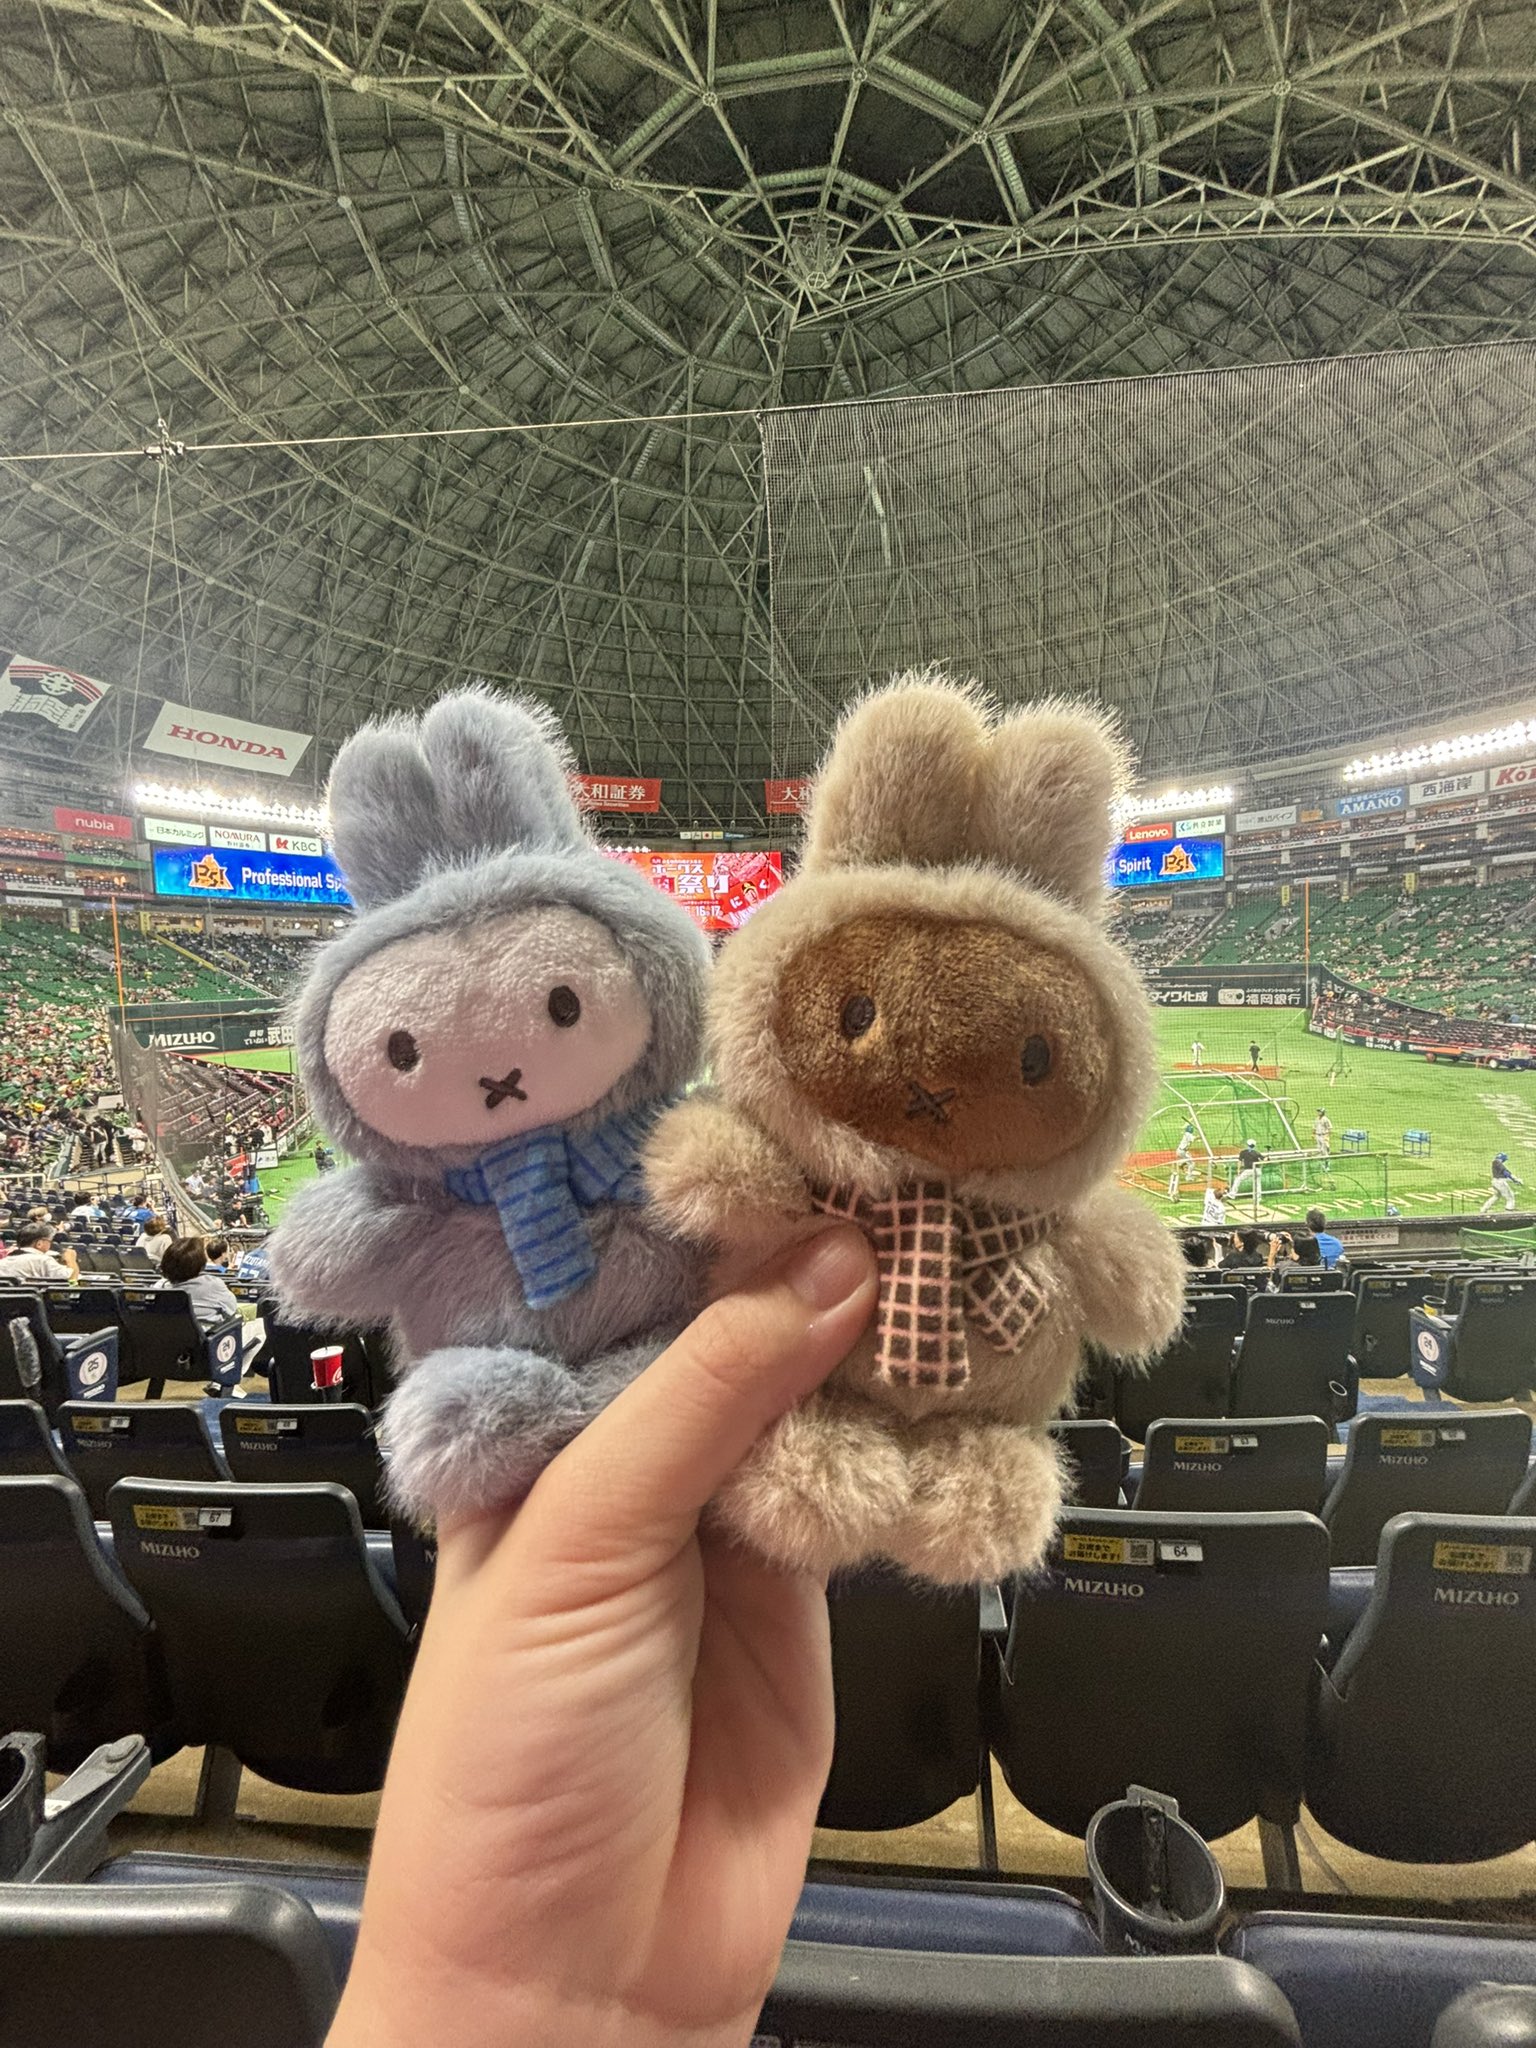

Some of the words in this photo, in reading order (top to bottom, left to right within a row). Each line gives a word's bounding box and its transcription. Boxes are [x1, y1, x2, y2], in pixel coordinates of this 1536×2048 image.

[166, 723, 287, 760] HONDA
[1422, 775, 1473, 797] 西海岸
[1340, 795, 1402, 815] AMANO
[75, 817, 114, 831] nubia
[214, 830, 260, 843] NOMURA
[1129, 828, 1169, 841] Lenovo
[292, 840, 317, 853] KBC
[652, 864, 704, 874] ホークス
[1119, 856, 1152, 875] Spirit
[241, 867, 322, 889] Professional
[1246, 993, 1301, 1005] 福岡銀行
[149, 1031, 216, 1047] MIZUHO
[87, 1357, 100, 1373] 25
[1173, 1461, 1222, 1472] MIZUHO
[1379, 1455, 1429, 1465] MIZUHO
[140, 1540, 200, 1559] MIZUHO
[1173, 1545, 1189, 1558] 64
[1064, 1577, 1145, 1598] MIZUHO
[1434, 1587, 1520, 1606] MIZUHO
